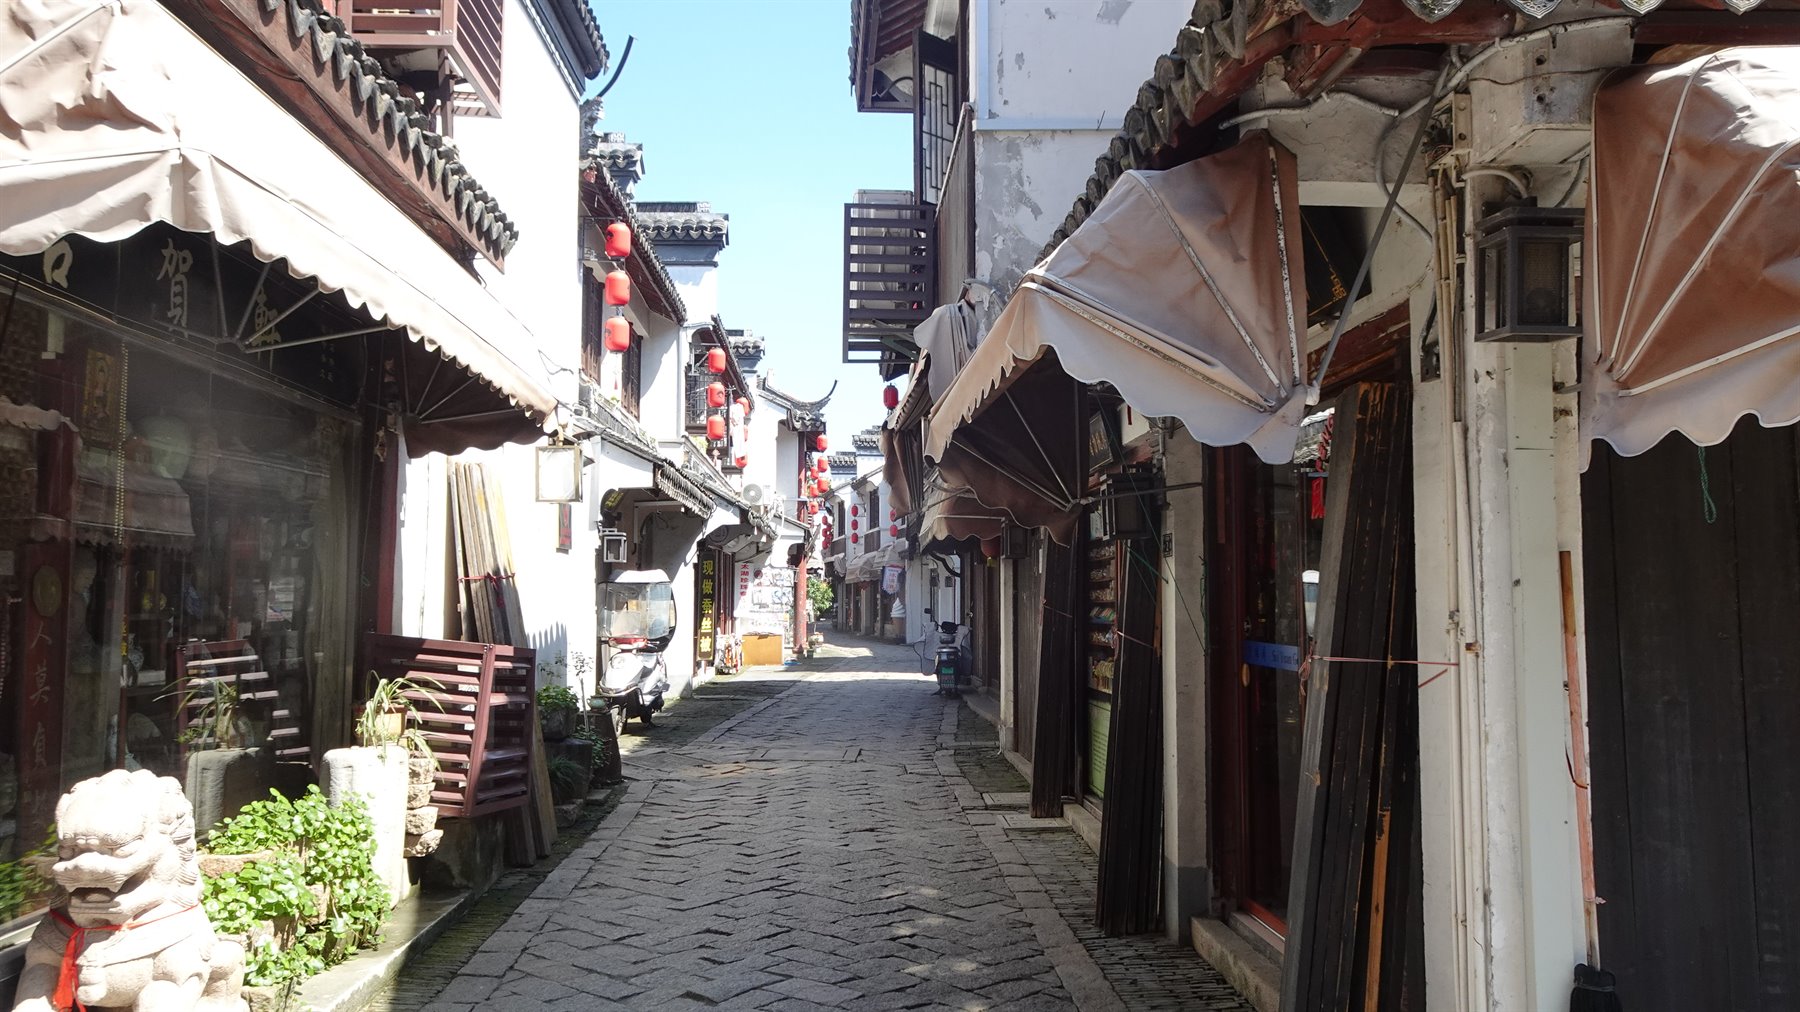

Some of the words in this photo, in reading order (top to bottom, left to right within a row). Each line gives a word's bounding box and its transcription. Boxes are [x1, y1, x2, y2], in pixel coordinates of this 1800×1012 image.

[700, 560, 714, 653] 现做蚕丝被
